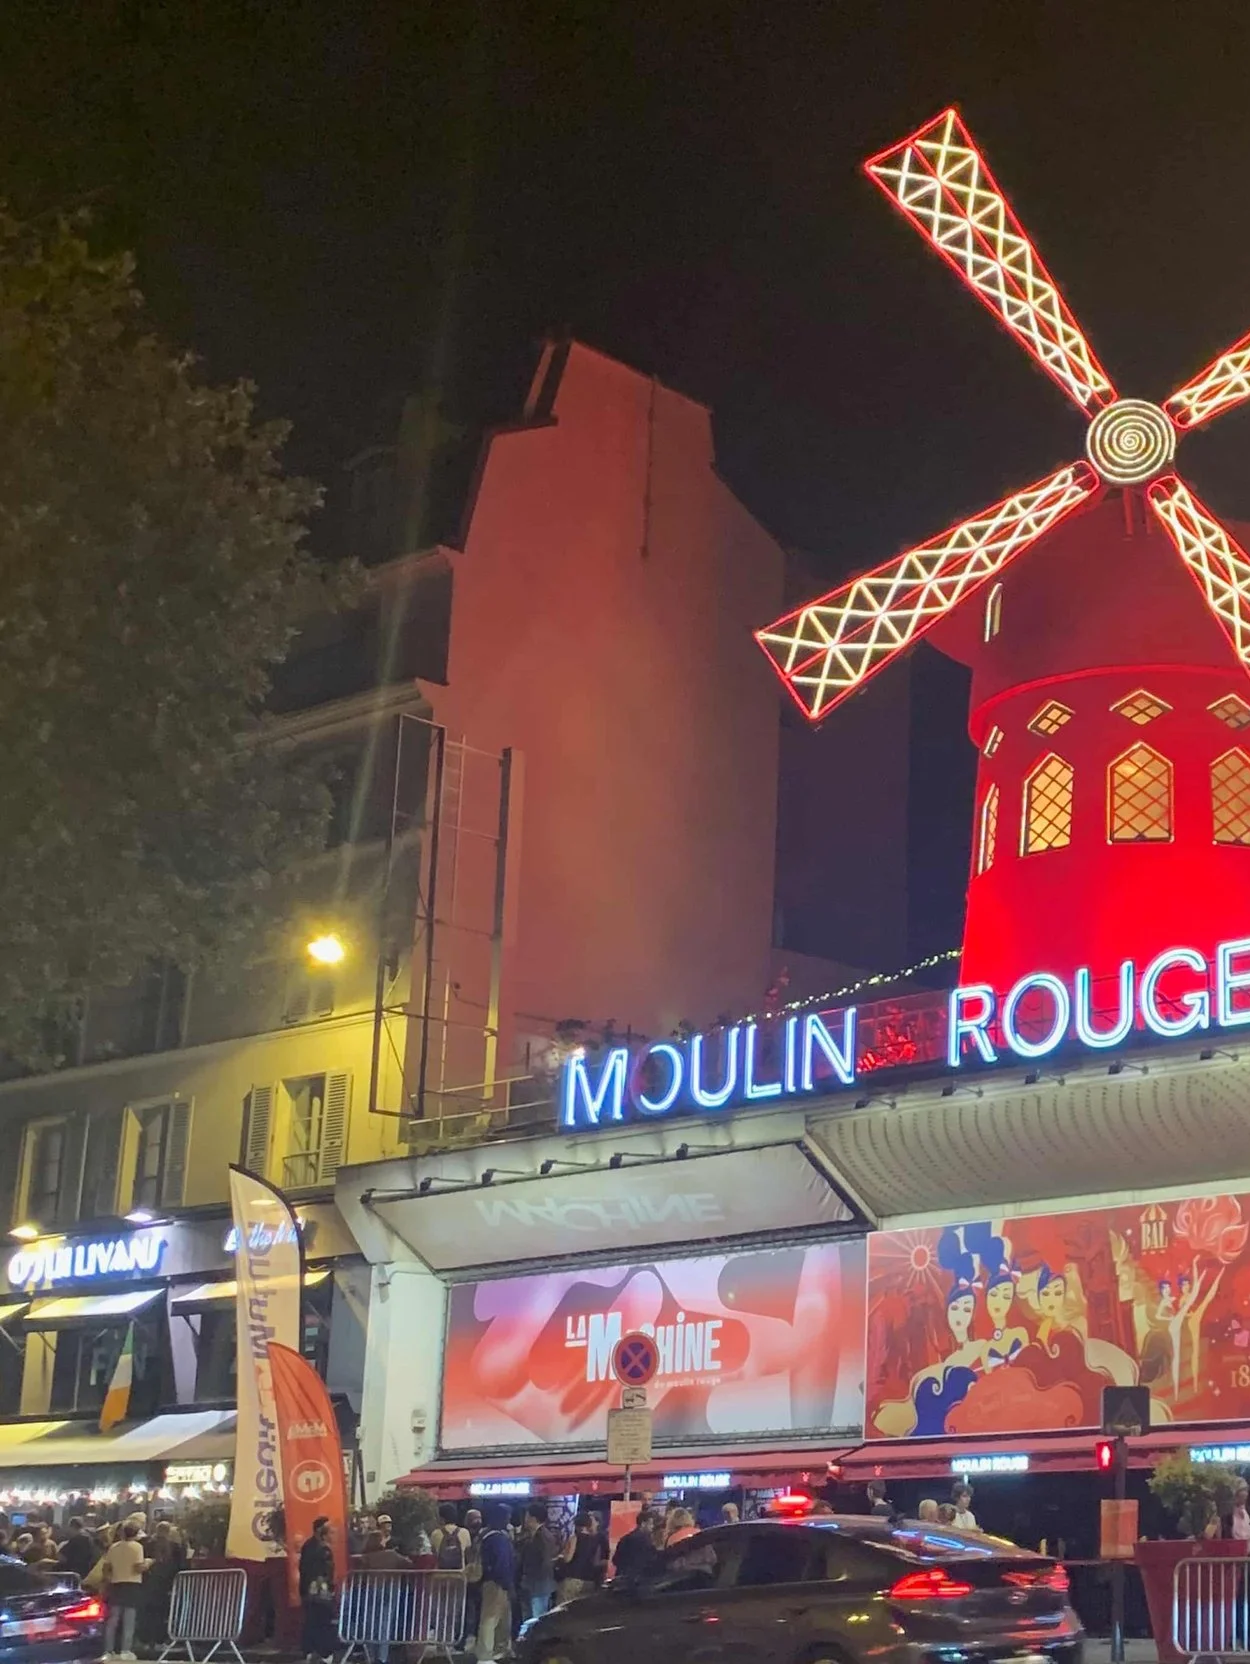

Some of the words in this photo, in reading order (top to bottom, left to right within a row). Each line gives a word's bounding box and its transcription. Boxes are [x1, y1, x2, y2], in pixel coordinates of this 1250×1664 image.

[564, 1006, 857, 1126] MOULIN
[1141, 1221, 1169, 1250] BAL
[566, 1314, 587, 1340] LA
